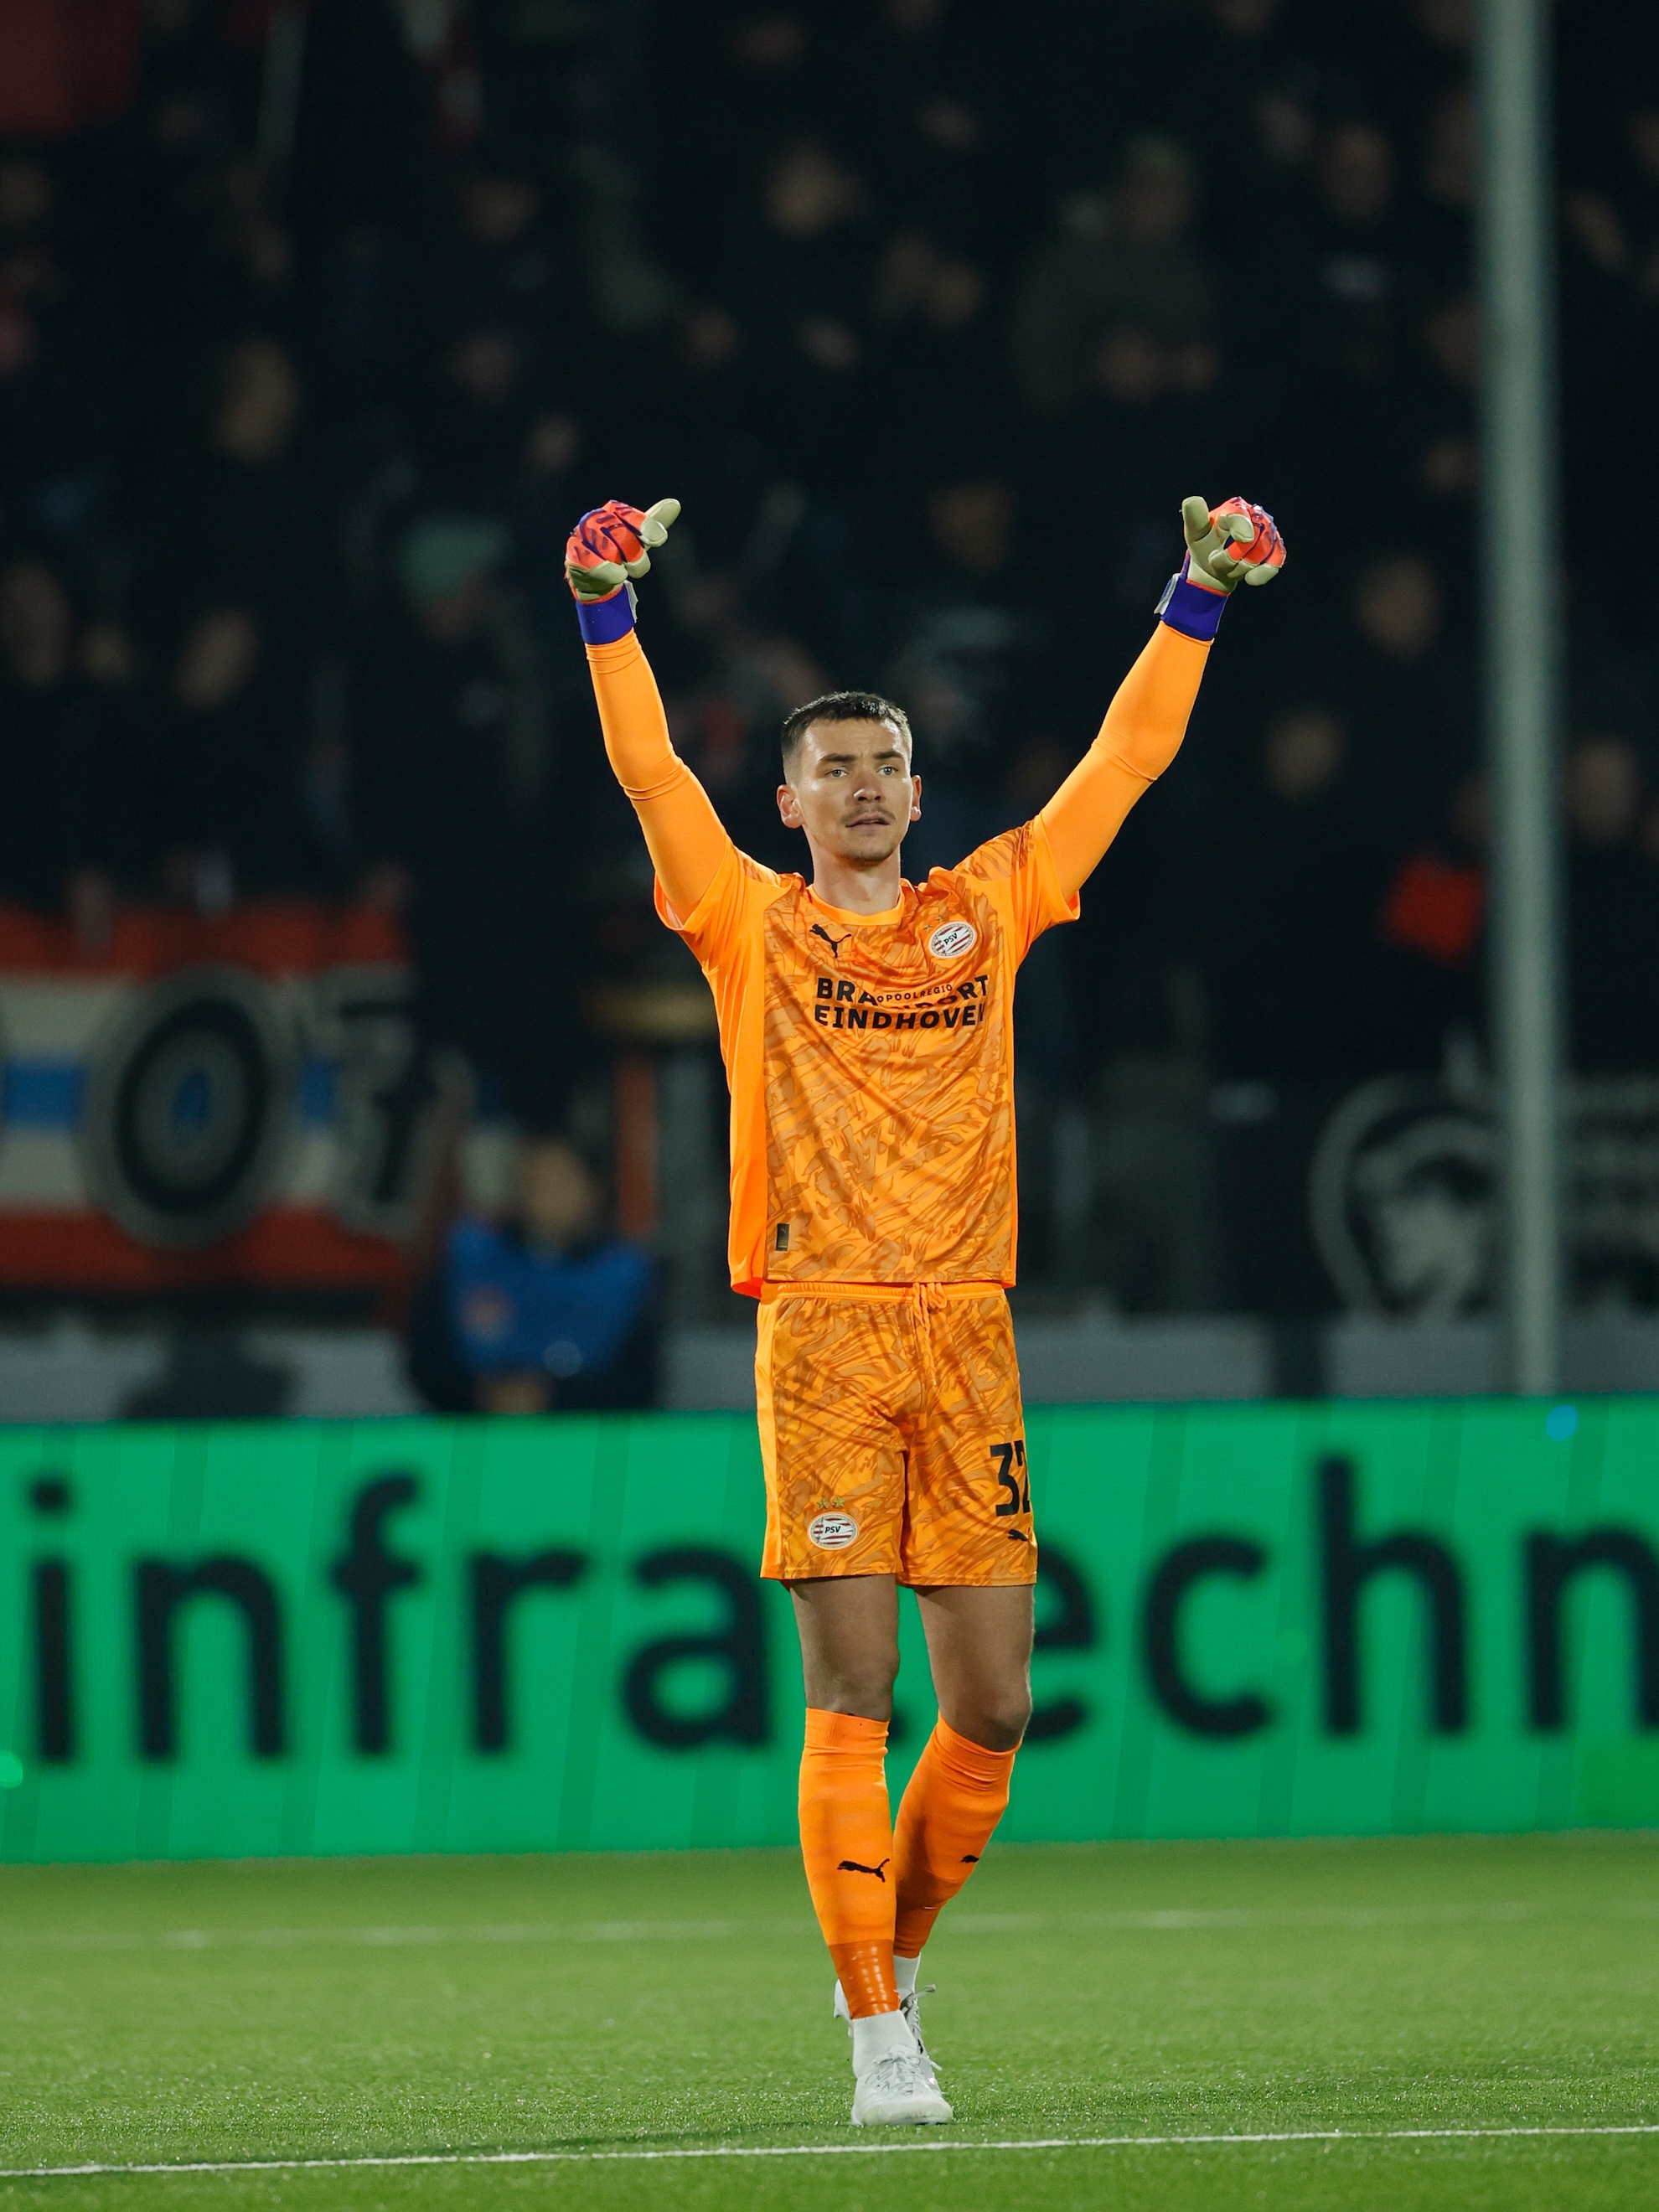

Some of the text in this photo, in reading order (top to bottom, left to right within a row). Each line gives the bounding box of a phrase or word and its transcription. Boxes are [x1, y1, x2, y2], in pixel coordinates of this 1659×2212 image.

[943, 932, 958, 945] PSV
[817, 974, 989, 1010] BRAORT
[824, 1525, 841, 1534] PSV
